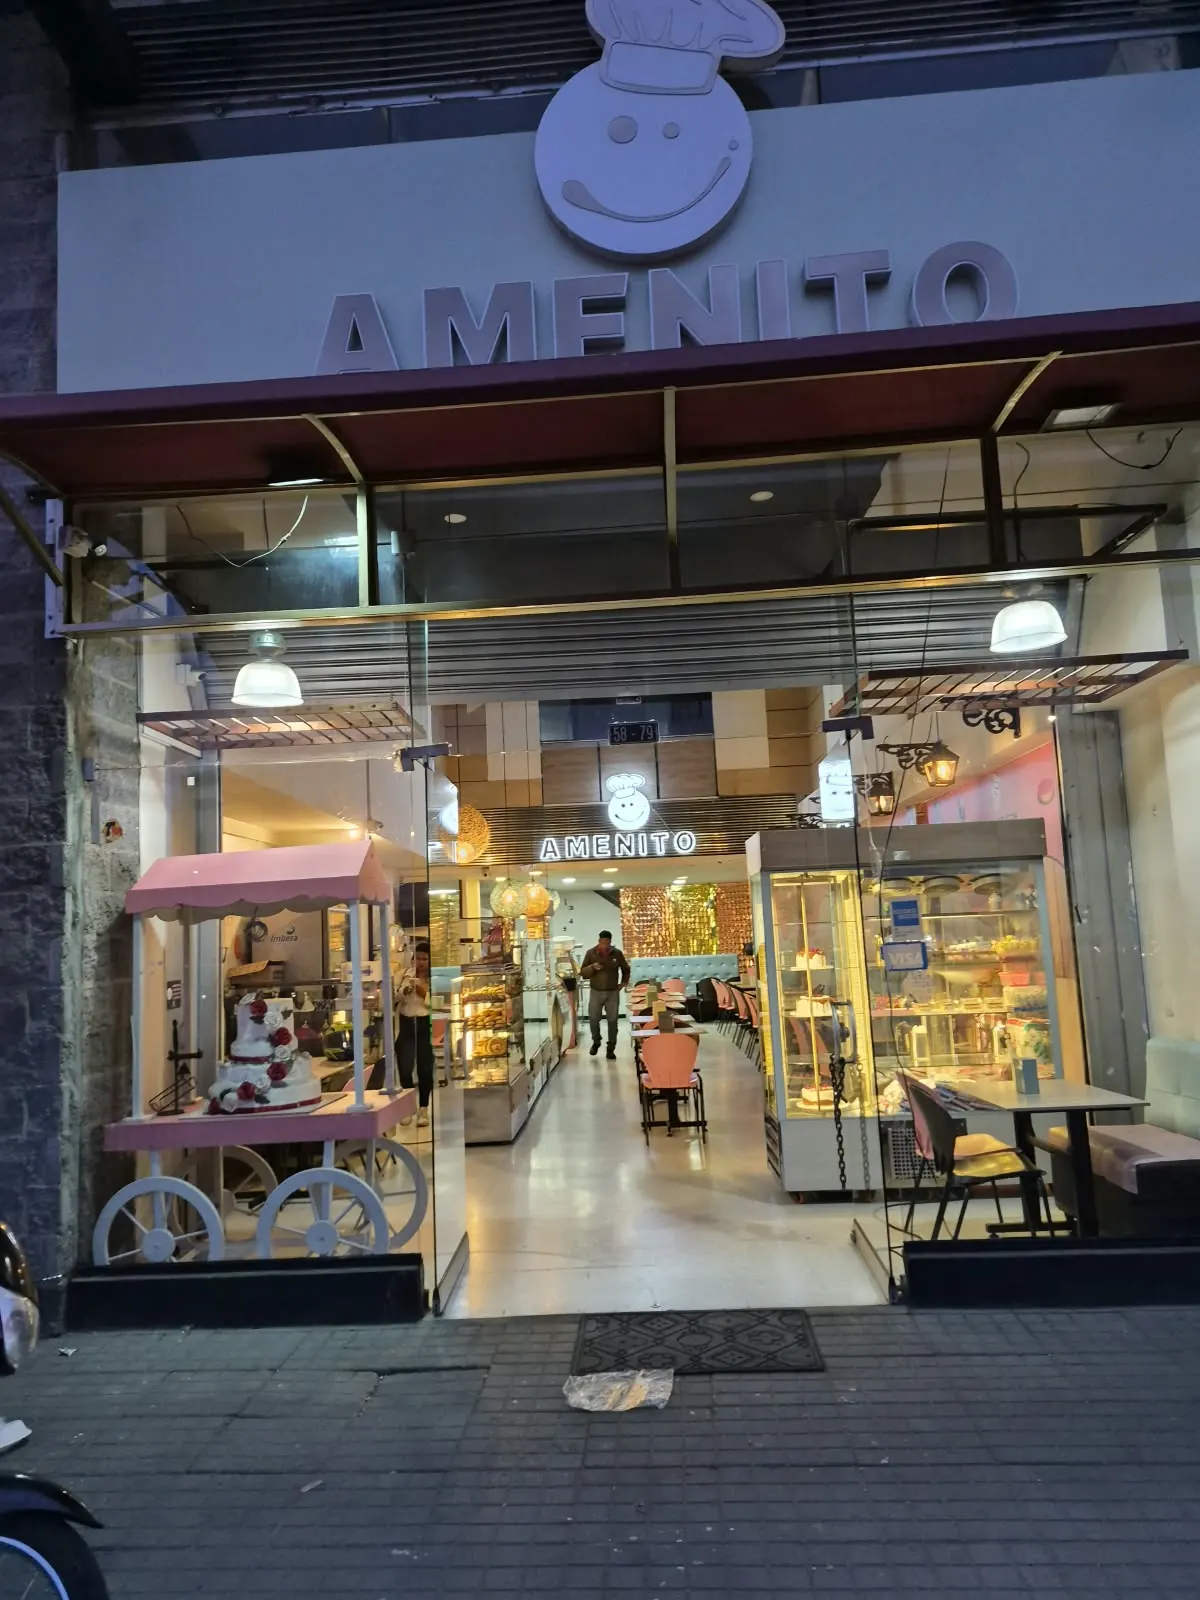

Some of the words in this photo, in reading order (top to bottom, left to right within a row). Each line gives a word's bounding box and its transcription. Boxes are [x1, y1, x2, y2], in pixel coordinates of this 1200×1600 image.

[314, 240, 1019, 376] AMENITO
[613, 726, 628, 742] 58
[639, 724, 654, 741] 79
[540, 831, 696, 861] AMENITO
[888, 952, 922, 965] VISA
